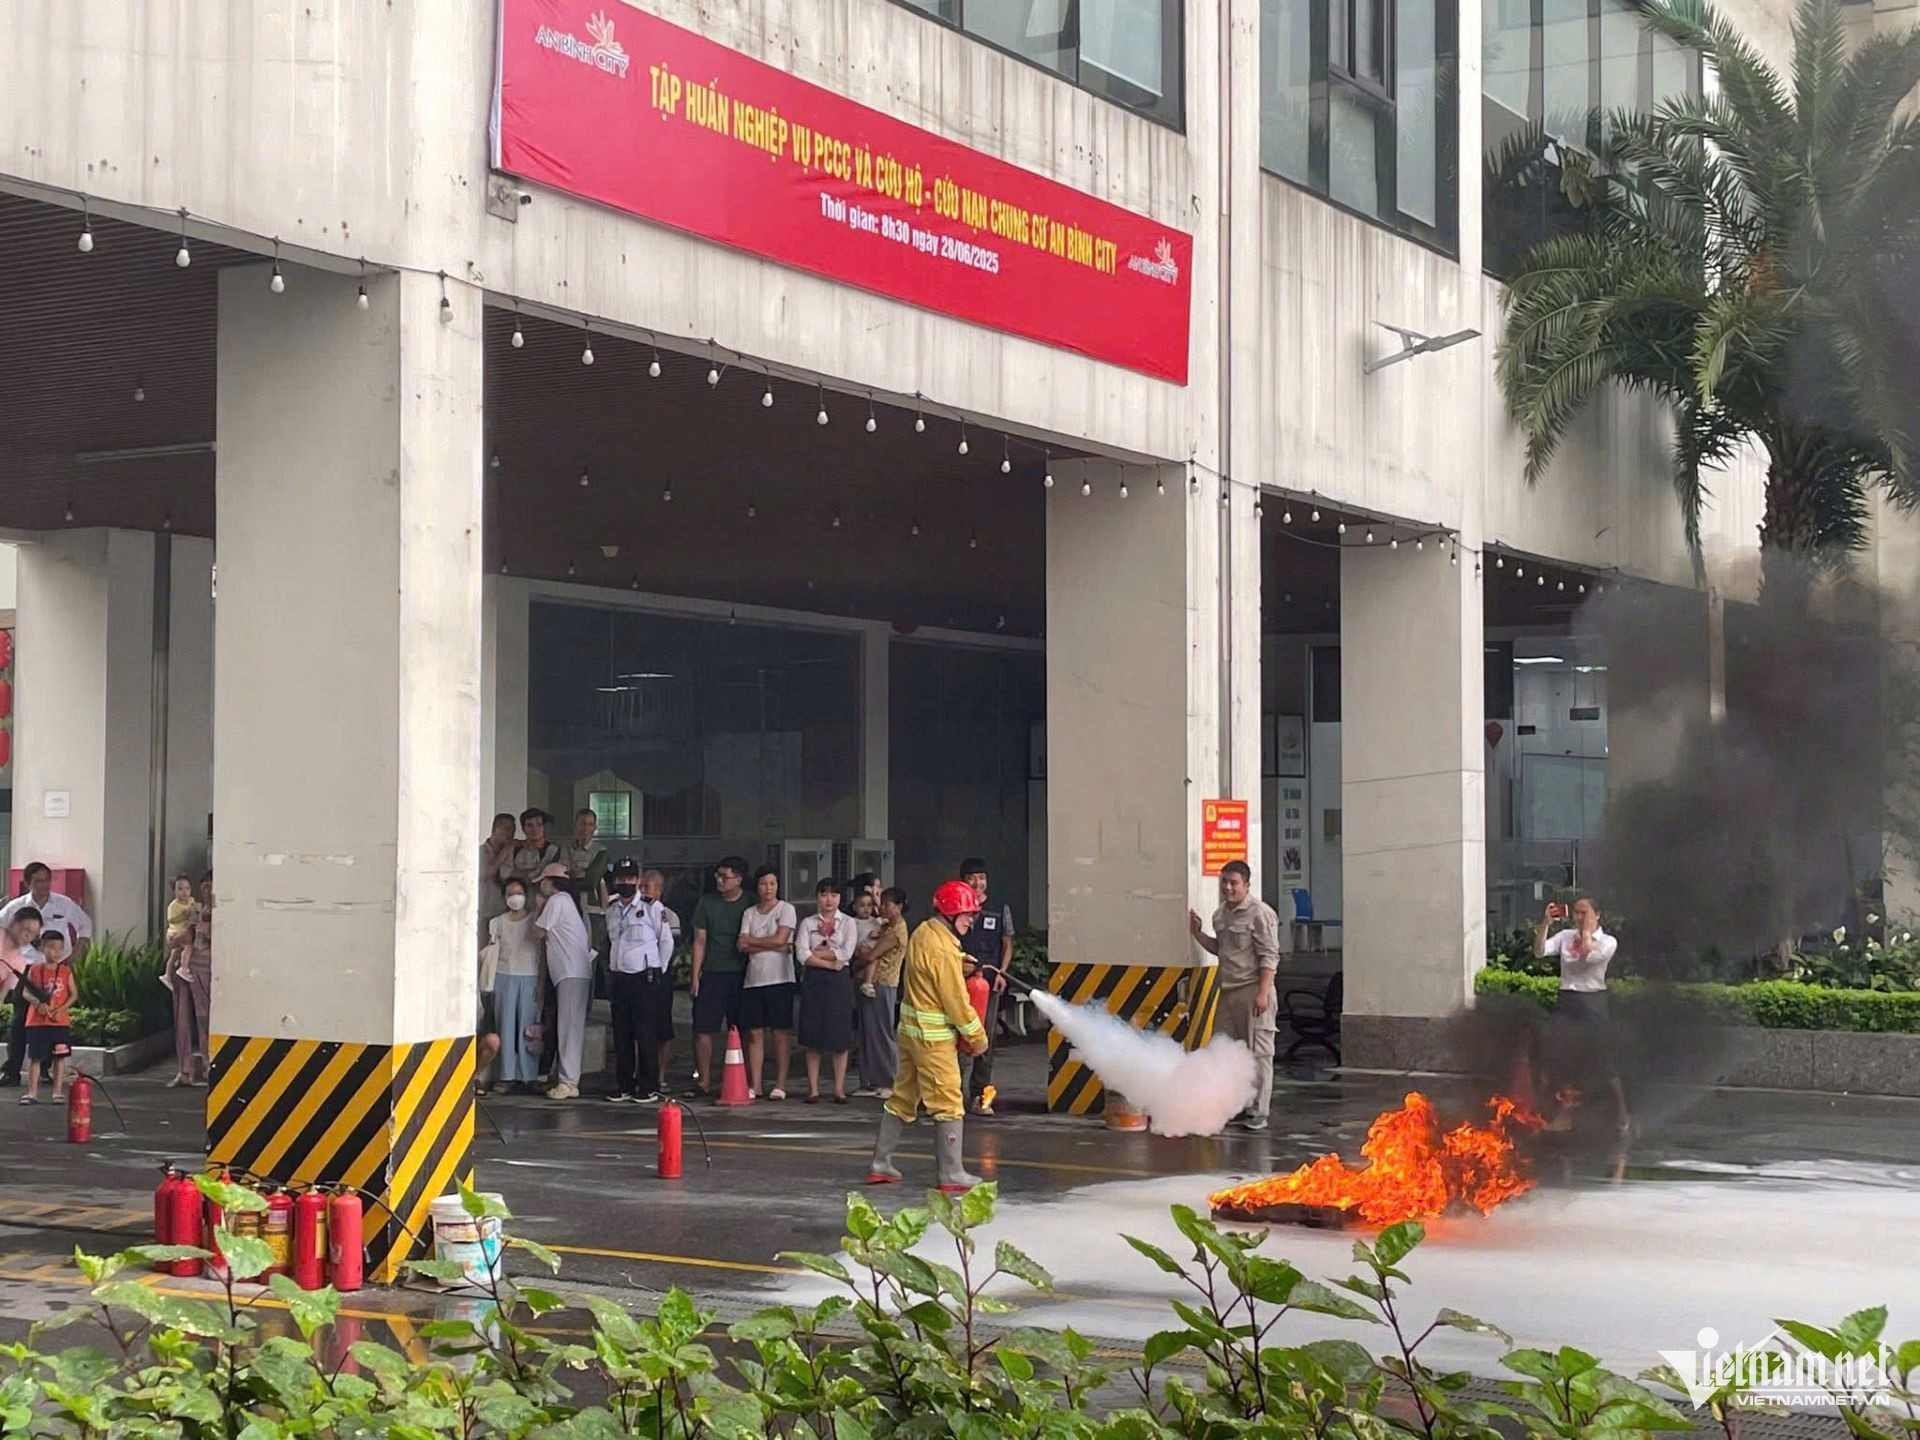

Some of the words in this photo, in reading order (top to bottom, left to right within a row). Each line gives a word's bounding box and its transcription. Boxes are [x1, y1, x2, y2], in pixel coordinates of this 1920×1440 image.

[650, 62, 681, 121] TẬP
[685, 77, 729, 136] HUẤN
[733, 99, 787, 162] NGHIỆP
[792, 122, 811, 174] VỤ
[814, 131, 851, 181] PCCC
[855, 143, 873, 189] VÀ
[875, 152, 902, 200] CỨU
[905, 164, 922, 215] HỘ
[934, 174, 959, 220] CỨU
[962, 187, 987, 235] NẠN
[990, 199, 1029, 245] CHUNG
[1031, 214, 1048, 251] CƯ
[1050, 221, 1065, 257] AN
[1067, 221, 1093, 268] BÌNH
[1095, 237, 1117, 276] CITY
[820, 192, 846, 224] Thời
[849, 205, 879, 234] gian:
[881, 214, 910, 245] 8h30
[912, 228, 939, 256] ngày
[941, 235, 1000, 275] 28/06/2025
